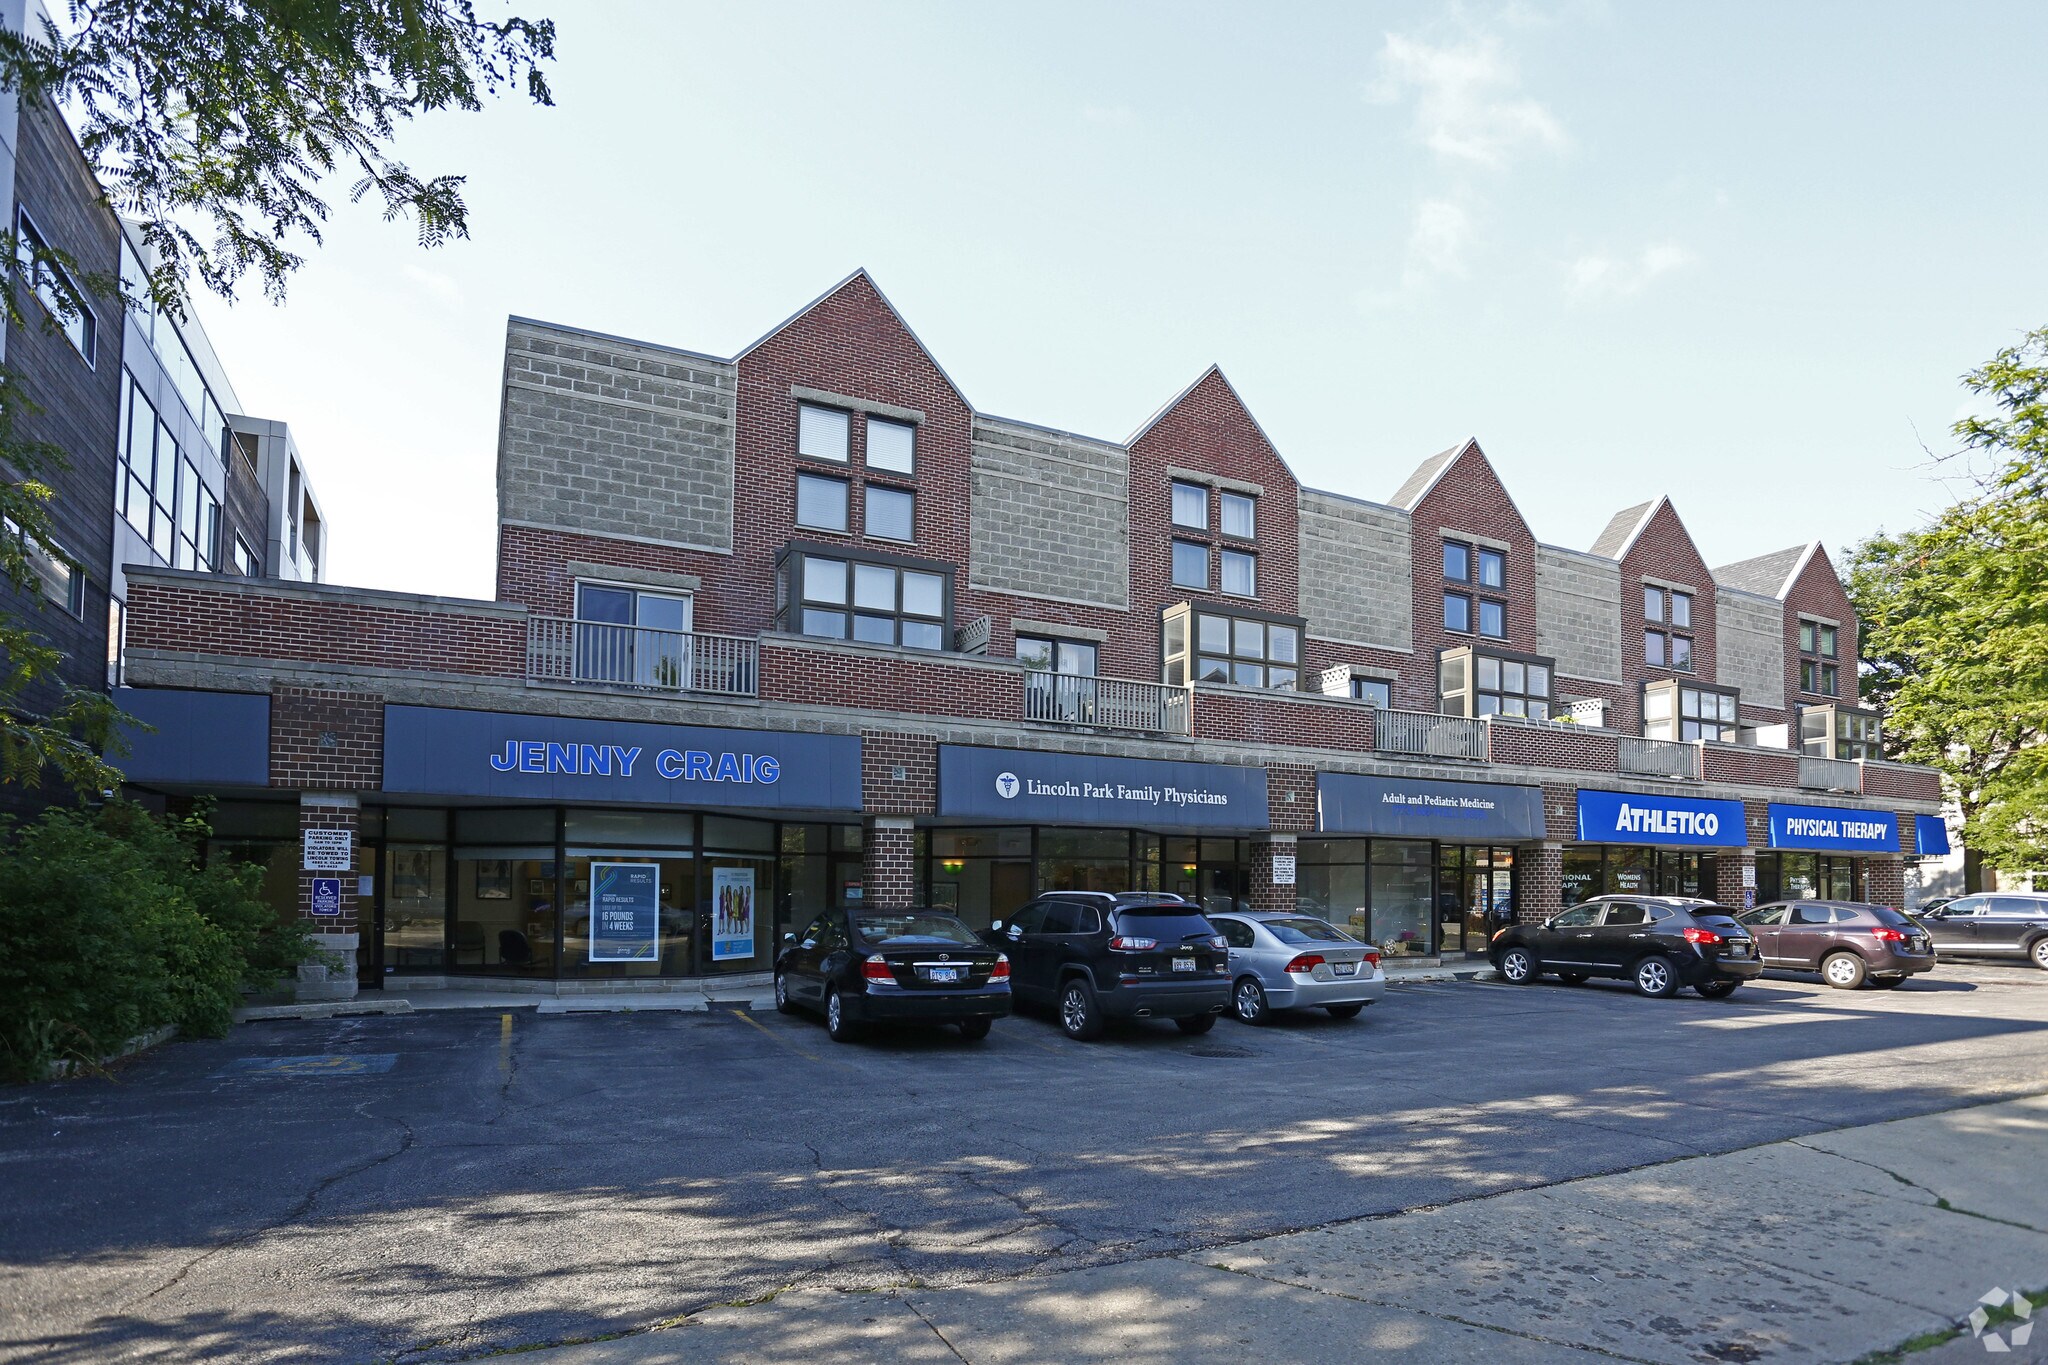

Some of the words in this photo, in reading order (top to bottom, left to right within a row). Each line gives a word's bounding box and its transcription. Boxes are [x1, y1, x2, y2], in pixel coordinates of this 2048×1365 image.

[490, 740, 642, 777] JENNY
[655, 748, 780, 784] CRAIG
[1027, 779, 1080, 797] Lincoln
[1083, 782, 1114, 799] Park
[1117, 785, 1160, 806] Family
[1164, 788, 1228, 807] Physicians
[1382, 792, 1406, 804] Adult
[1407, 795, 1423, 805] and
[1424, 795, 1459, 807] Pediatric
[1459, 797, 1495, 809] Medicine
[1615, 803, 1719, 836] ATHLETICO
[1786, 817, 1839, 838] PHYSICAL
[1841, 820, 1888, 840] THERAPY
[1619, 881, 1639, 889] HEALTH
[601, 911, 609, 921] 16
[609, 911, 634, 921] POUNDS
[609, 921, 613, 930] 4
[613, 921, 634, 930] WEEKS
